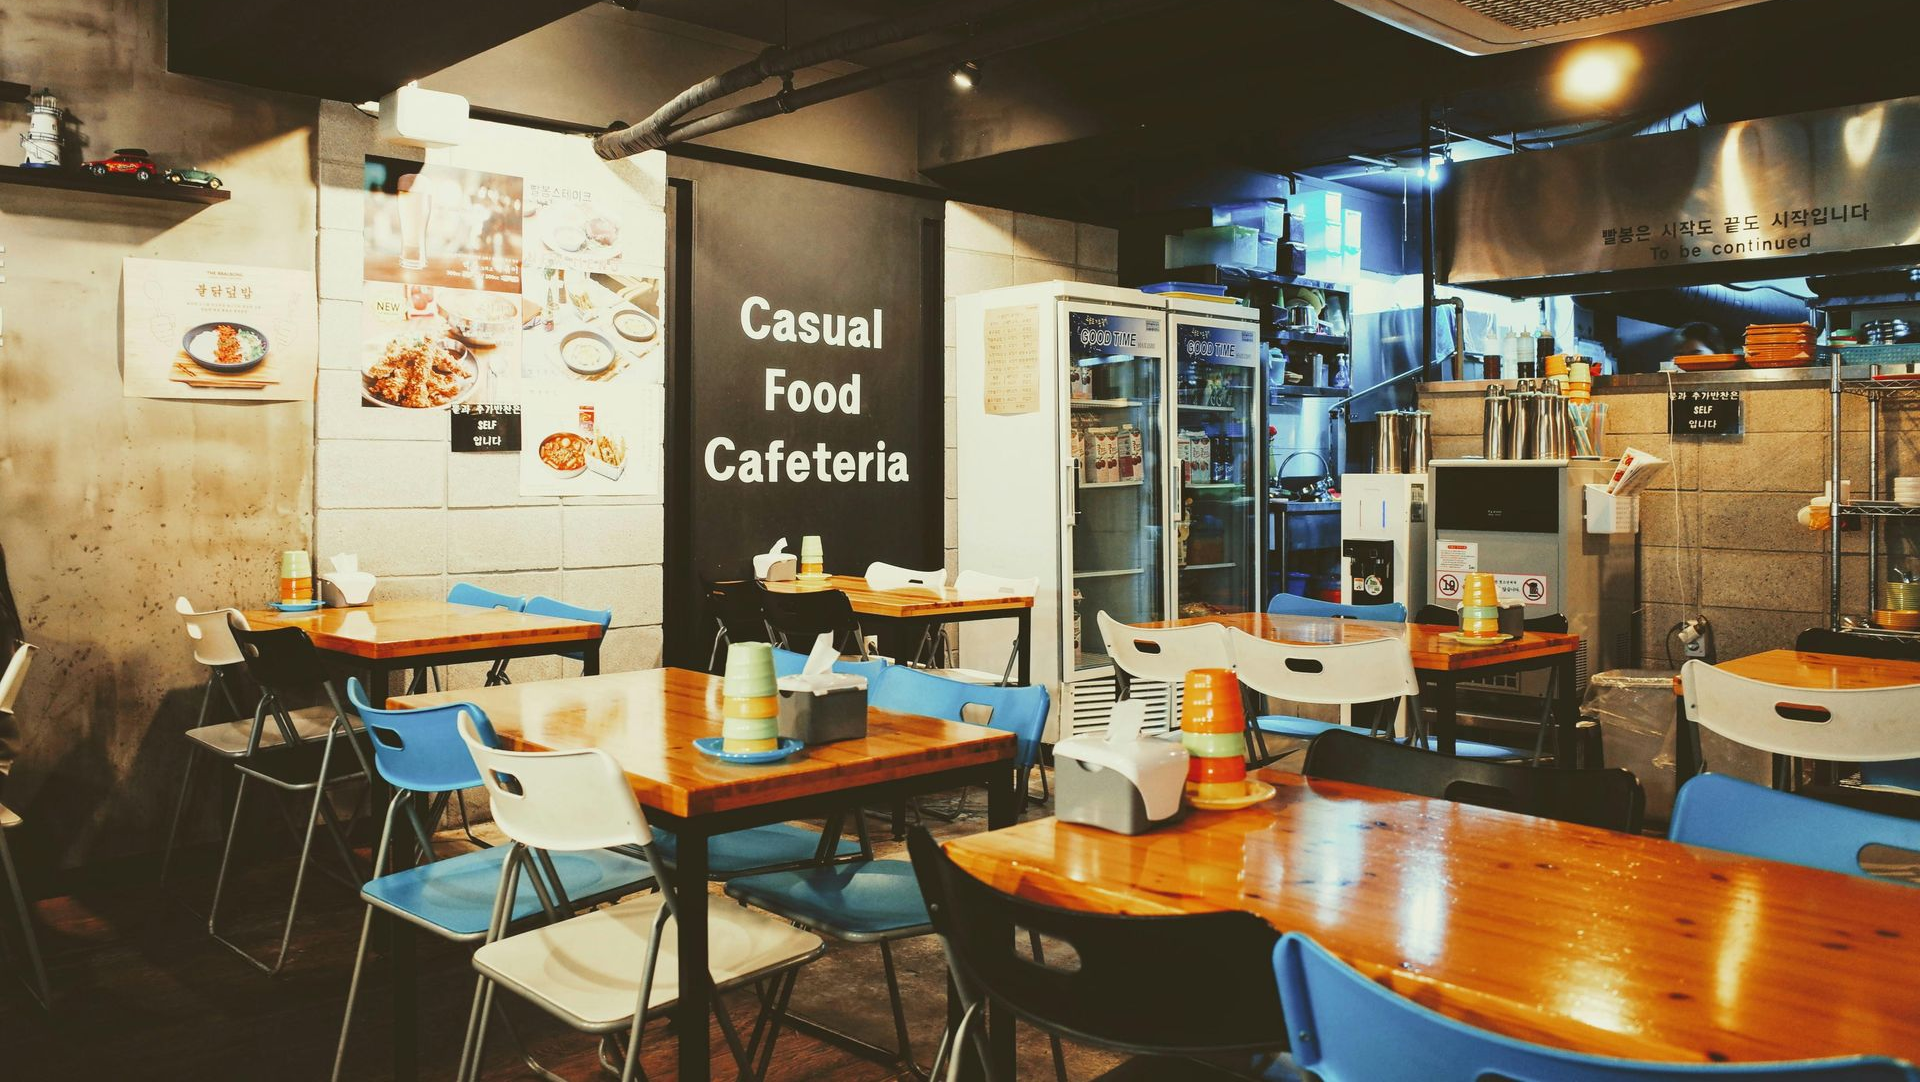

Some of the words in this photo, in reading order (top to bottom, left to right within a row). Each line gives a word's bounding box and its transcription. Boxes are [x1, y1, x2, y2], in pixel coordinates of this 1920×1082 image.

[1602, 225, 1651, 246] 빨봉은
[1662, 219, 1713, 239] 시작도
[1724, 216, 1760, 233] 끝도
[1771, 203, 1870, 228] 시작입니다
[1649, 247, 1669, 260] To
[1680, 245, 1701, 258] be
[1712, 234, 1811, 255] continued
[376, 301, 400, 312] NEW
[740, 296, 882, 349] Casual
[1080, 328, 1112, 346] GOOD
[1113, 331, 1137, 347] TIME
[1187, 340, 1214, 356] GOOD
[1215, 343, 1236, 358] TIME
[765, 368, 861, 414] Food
[1692, 391, 1739, 401] 추가반찬은
[1693, 405, 1713, 415] SELF
[477, 420, 497, 430] SELF
[1688, 420, 1717, 429] 입니다
[473, 435, 501, 446] 입니다
[704, 436, 910, 484] Cafeteria
